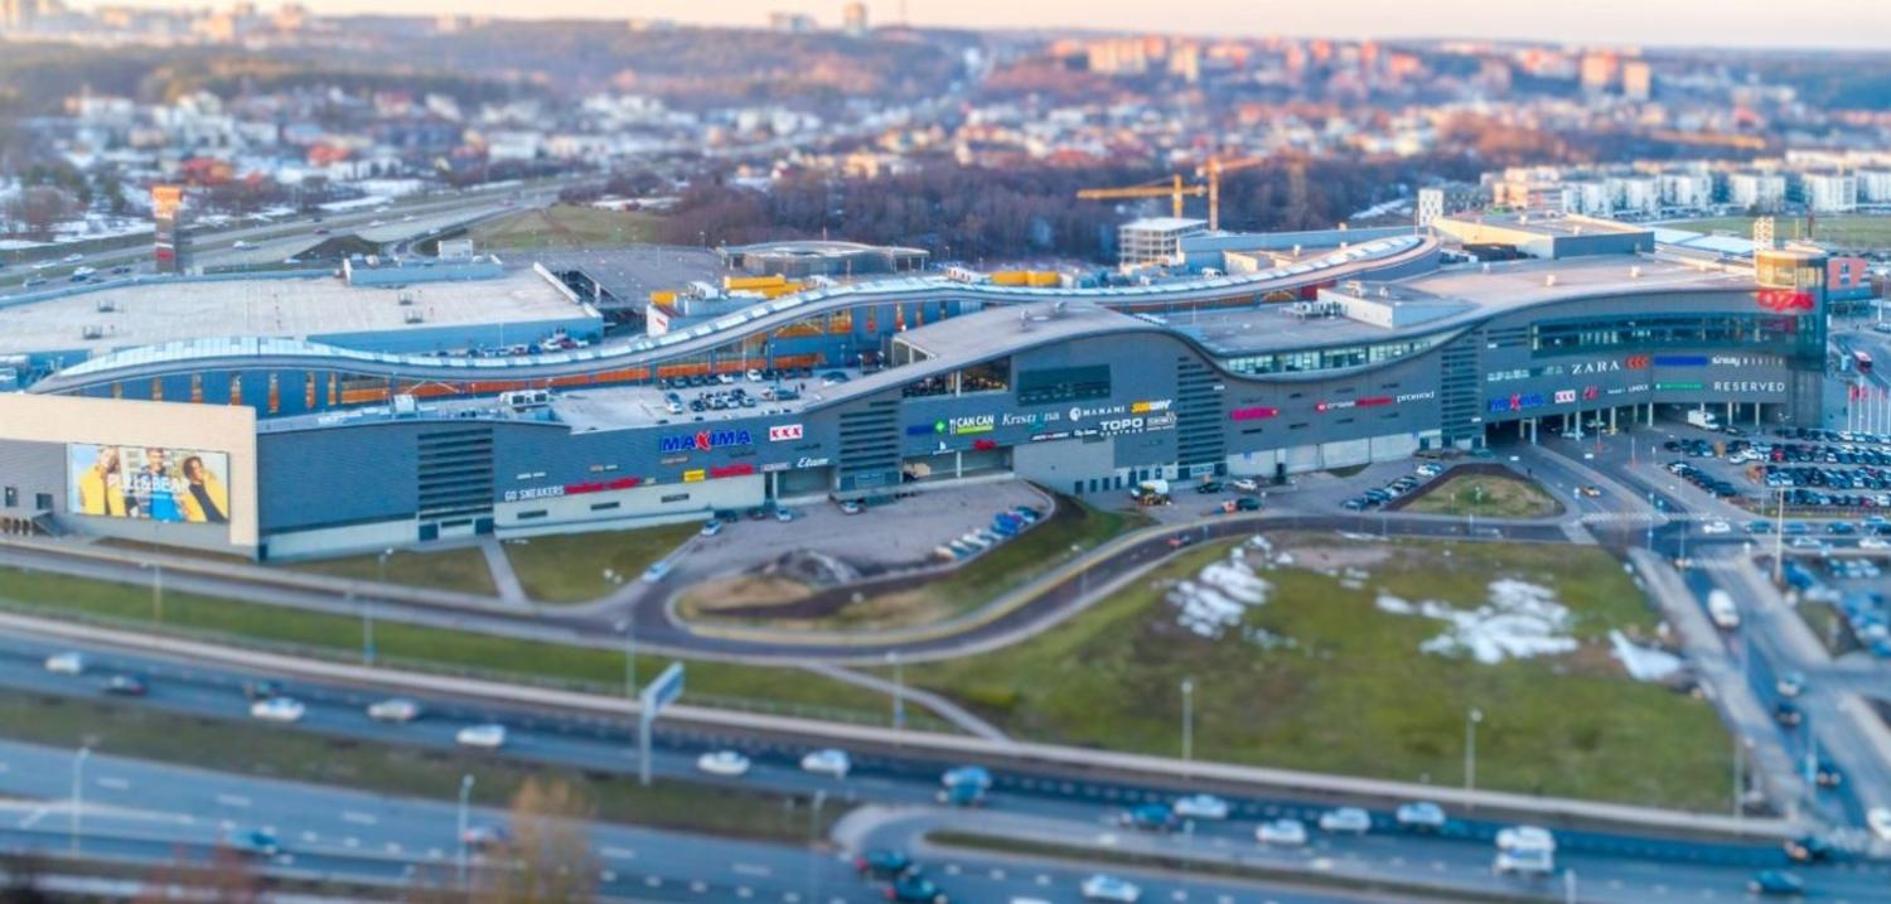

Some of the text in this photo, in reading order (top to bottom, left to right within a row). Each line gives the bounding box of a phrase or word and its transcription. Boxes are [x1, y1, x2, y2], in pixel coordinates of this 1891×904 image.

[1571, 360, 1621, 375] ZARA
[1713, 381, 1785, 393] RESERVED
[957, 416, 975, 428] CAN
[976, 414, 994, 425] CAN
[1100, 417, 1144, 431] TOPO
[661, 430, 752, 453] MAXIMA
